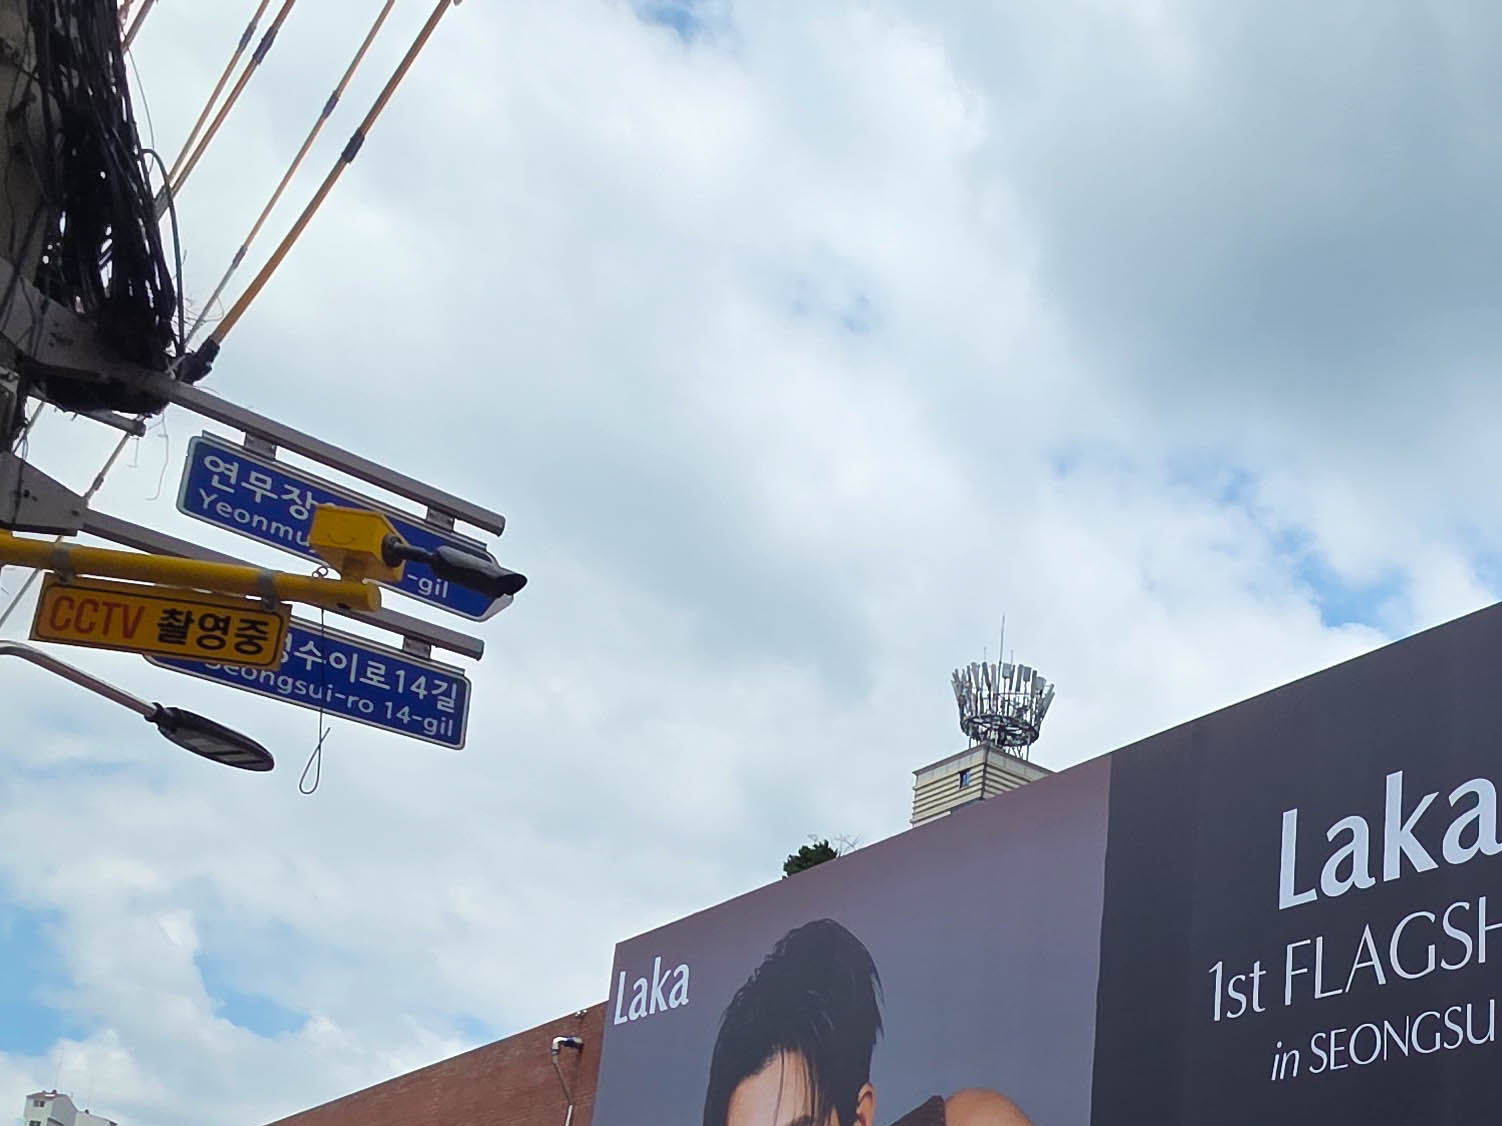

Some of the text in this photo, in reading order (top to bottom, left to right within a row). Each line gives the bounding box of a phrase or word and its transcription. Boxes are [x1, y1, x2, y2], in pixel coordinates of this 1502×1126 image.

[199, 488, 312, 548] Yeonmu
[204, 455, 320, 521] 연무장
[49, 595, 270, 657] CCTV 촬영중
[385, 701, 454, 737] 14-gil
[614, 956, 690, 1026] Laka
[1209, 960, 1267, 1022] 1st
[1271, 999, 1496, 1081] in SEONGSU
